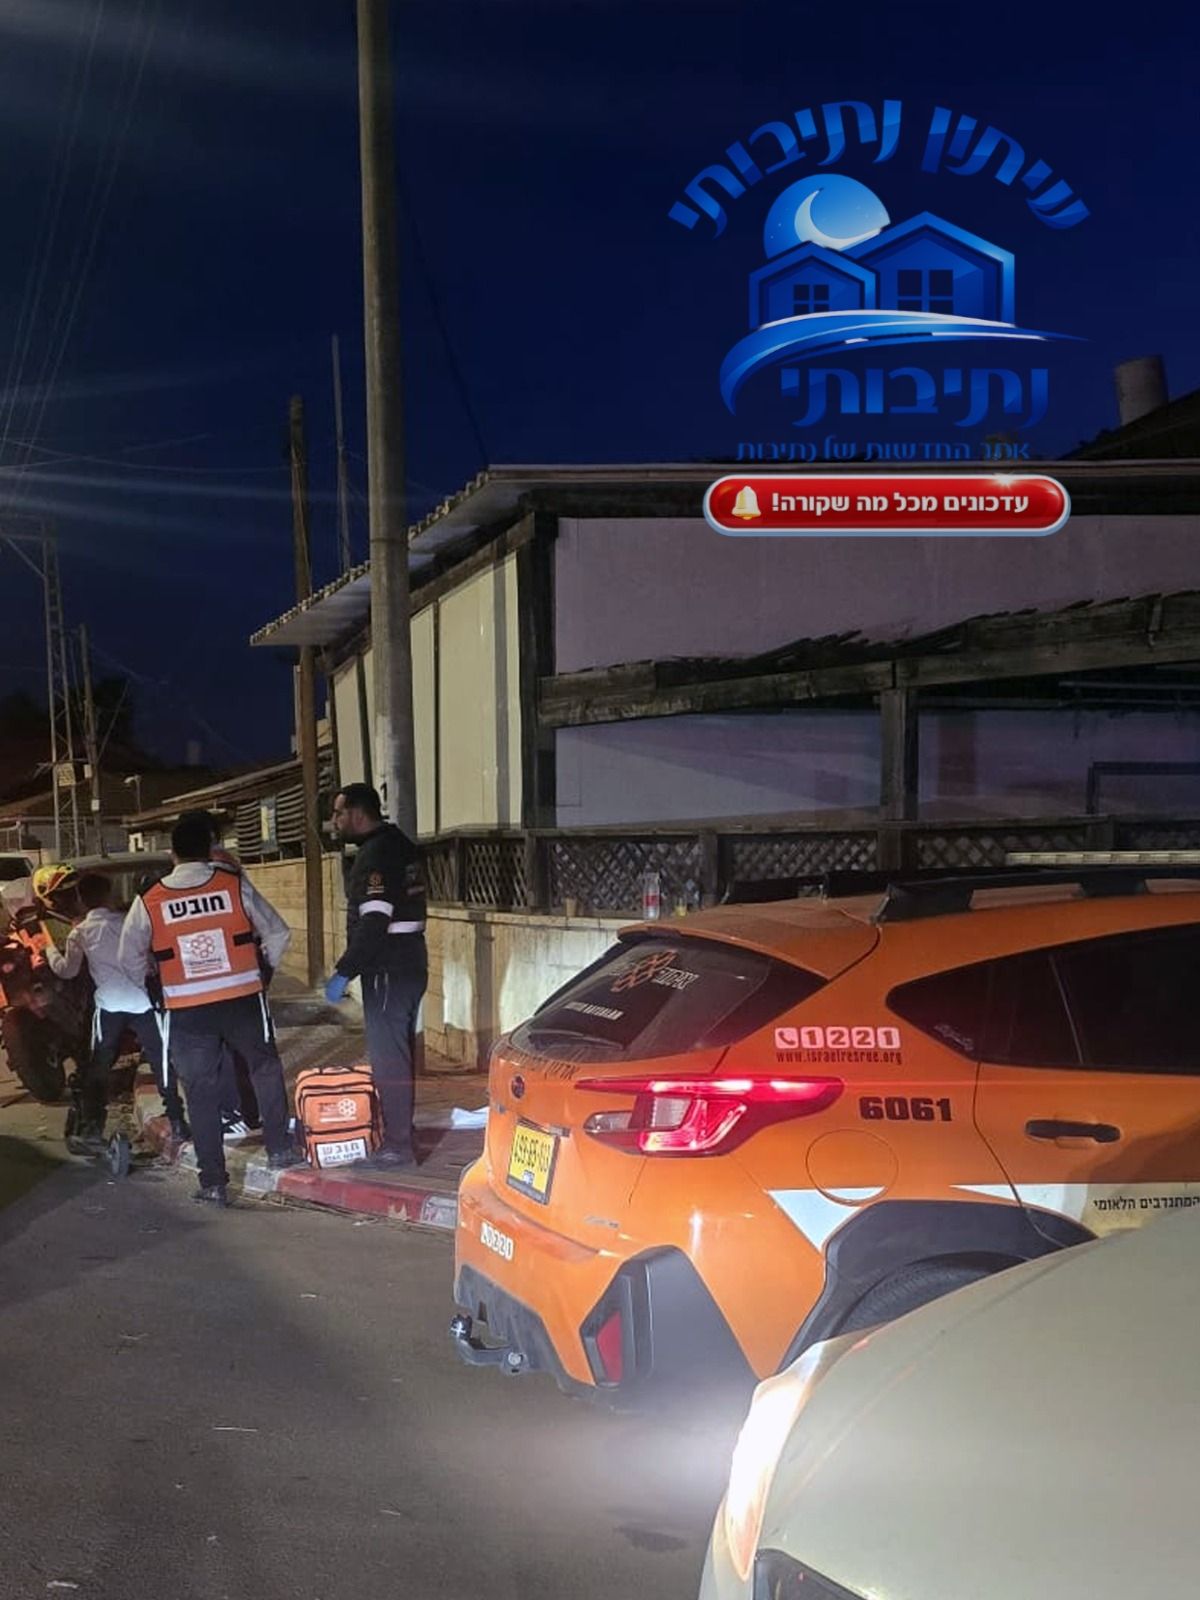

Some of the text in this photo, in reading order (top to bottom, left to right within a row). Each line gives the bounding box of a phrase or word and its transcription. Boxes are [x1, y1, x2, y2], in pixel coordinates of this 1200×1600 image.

[168, 895, 225, 919] חובש
[801, 1027, 900, 1048] 1221
[859, 1096, 952, 1122] 6061
[1093, 1195, 1136, 1211] הלאומי
